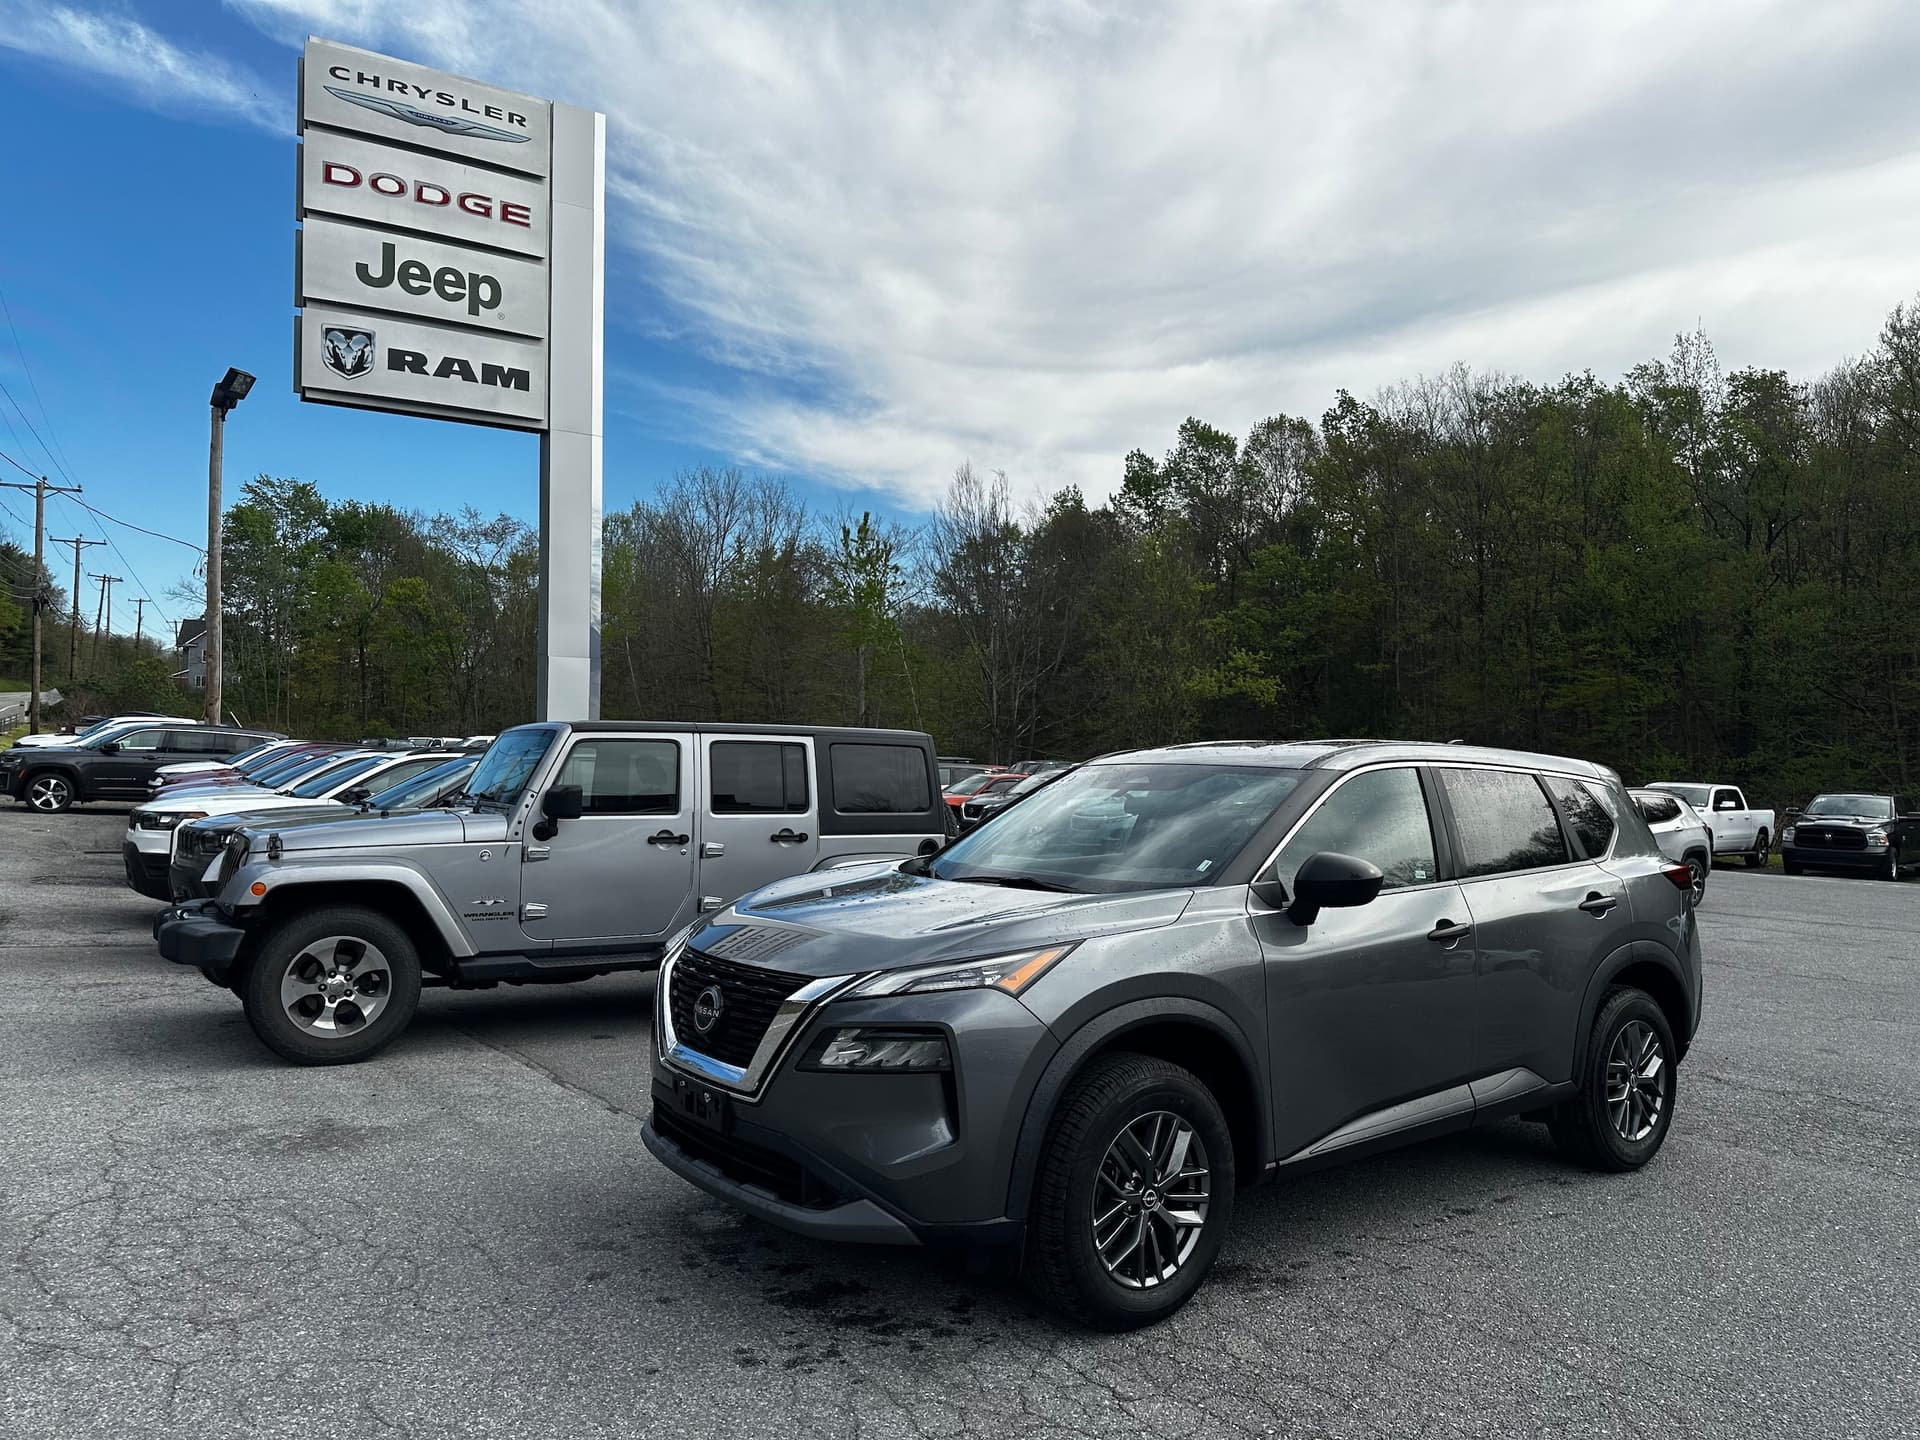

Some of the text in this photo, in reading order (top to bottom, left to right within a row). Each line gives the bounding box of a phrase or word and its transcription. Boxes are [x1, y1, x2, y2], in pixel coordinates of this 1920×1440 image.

[328, 66, 527, 128] CHRYSLER
[323, 161, 531, 228] DODGE
[355, 241, 502, 317] Jeep
[387, 347, 530, 392] RAM
